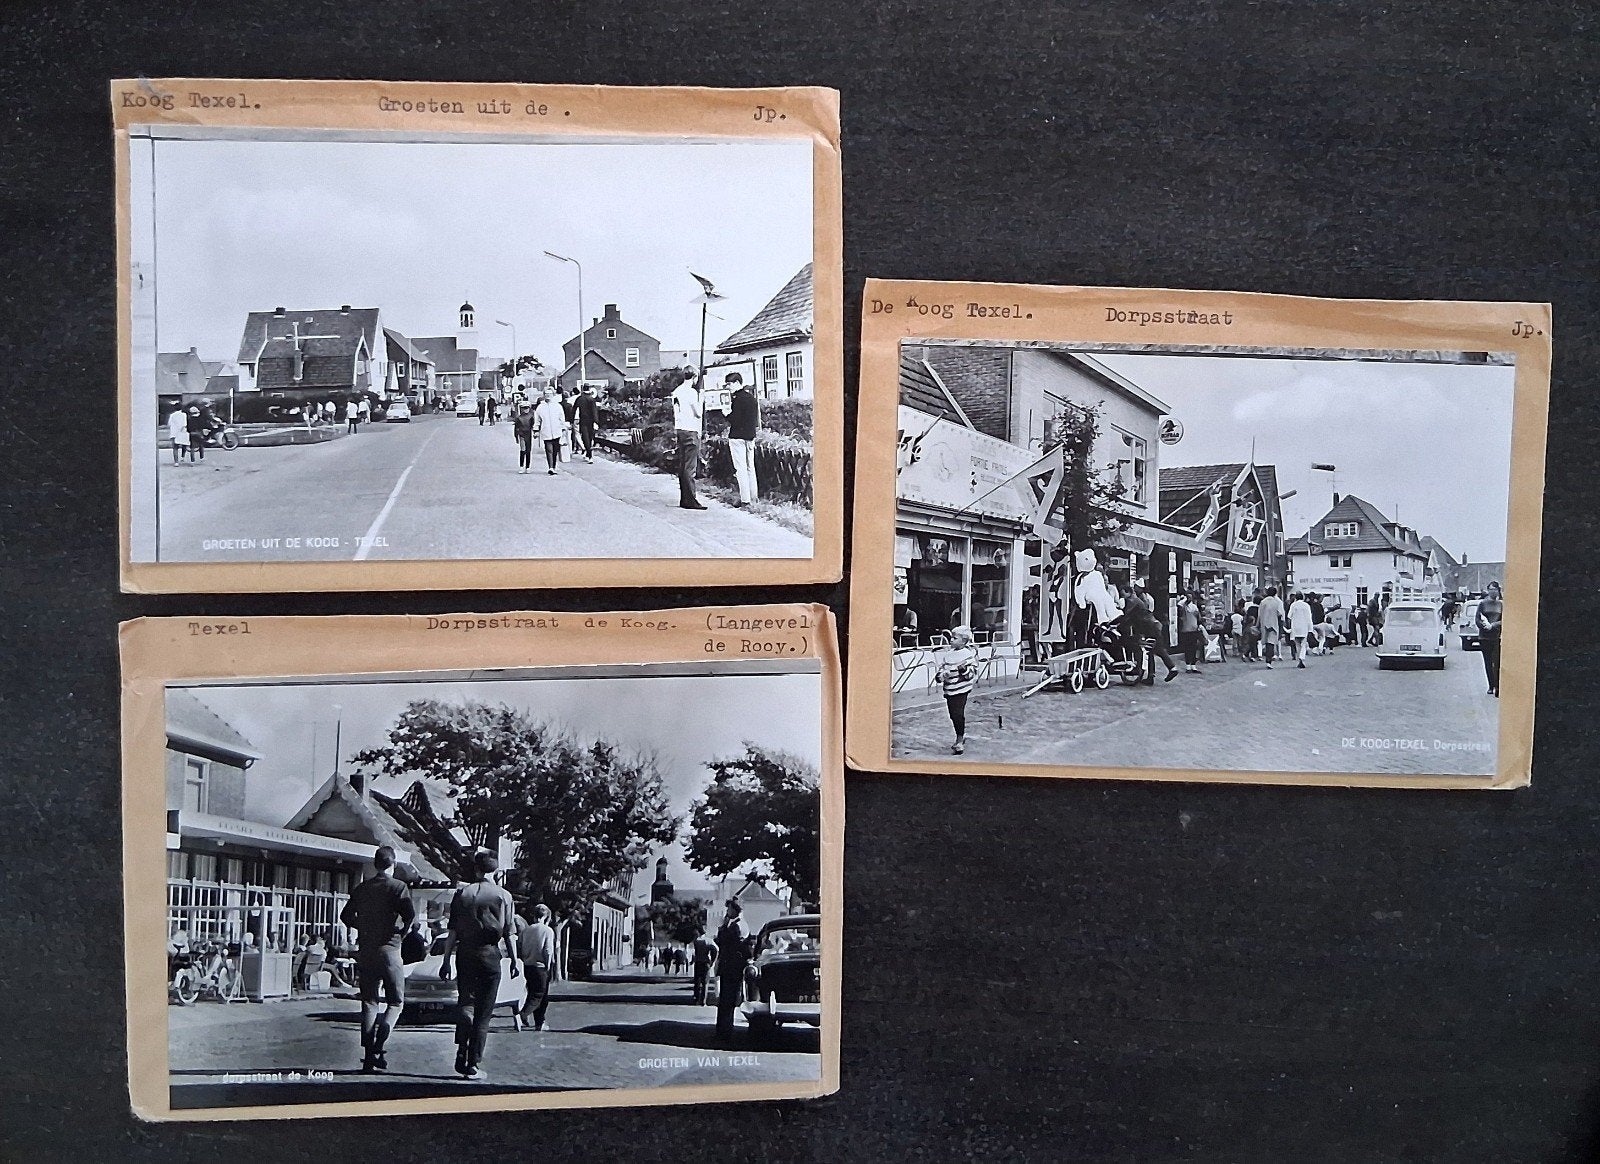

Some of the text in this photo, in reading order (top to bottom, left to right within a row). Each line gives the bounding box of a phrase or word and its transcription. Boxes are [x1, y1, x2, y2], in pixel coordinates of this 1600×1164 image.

[121, 91, 262, 111] Koog Texel.
[378, 95, 464, 114] Groeten
[476, 98, 512, 115] uit
[525, 99, 548, 116] de
[753, 105, 787, 124] Jp.
[870, 295, 1033, 320] De Koog Texel.
[1104, 307, 1234, 327] Dorpsstraat
[1511, 320, 1544, 339] Jp.
[202, 538, 256, 551] GROETEN
[262, 538, 281, 549] UIT
[286, 538, 301, 549] DE
[306, 537, 340, 548] KOOG
[188, 621, 252, 636] Texel
[426, 616, 560, 632] Dorpsstraat
[584, 617, 608, 628] de
[620, 618, 678, 632] Koog.
[703, 636, 808, 656] de Rooy.)
[1341, 737, 1356, 748] DE
[637, 1055, 761, 1069] GROETEN VAN TEXEL
[307, 1069, 335, 1082] Koog
